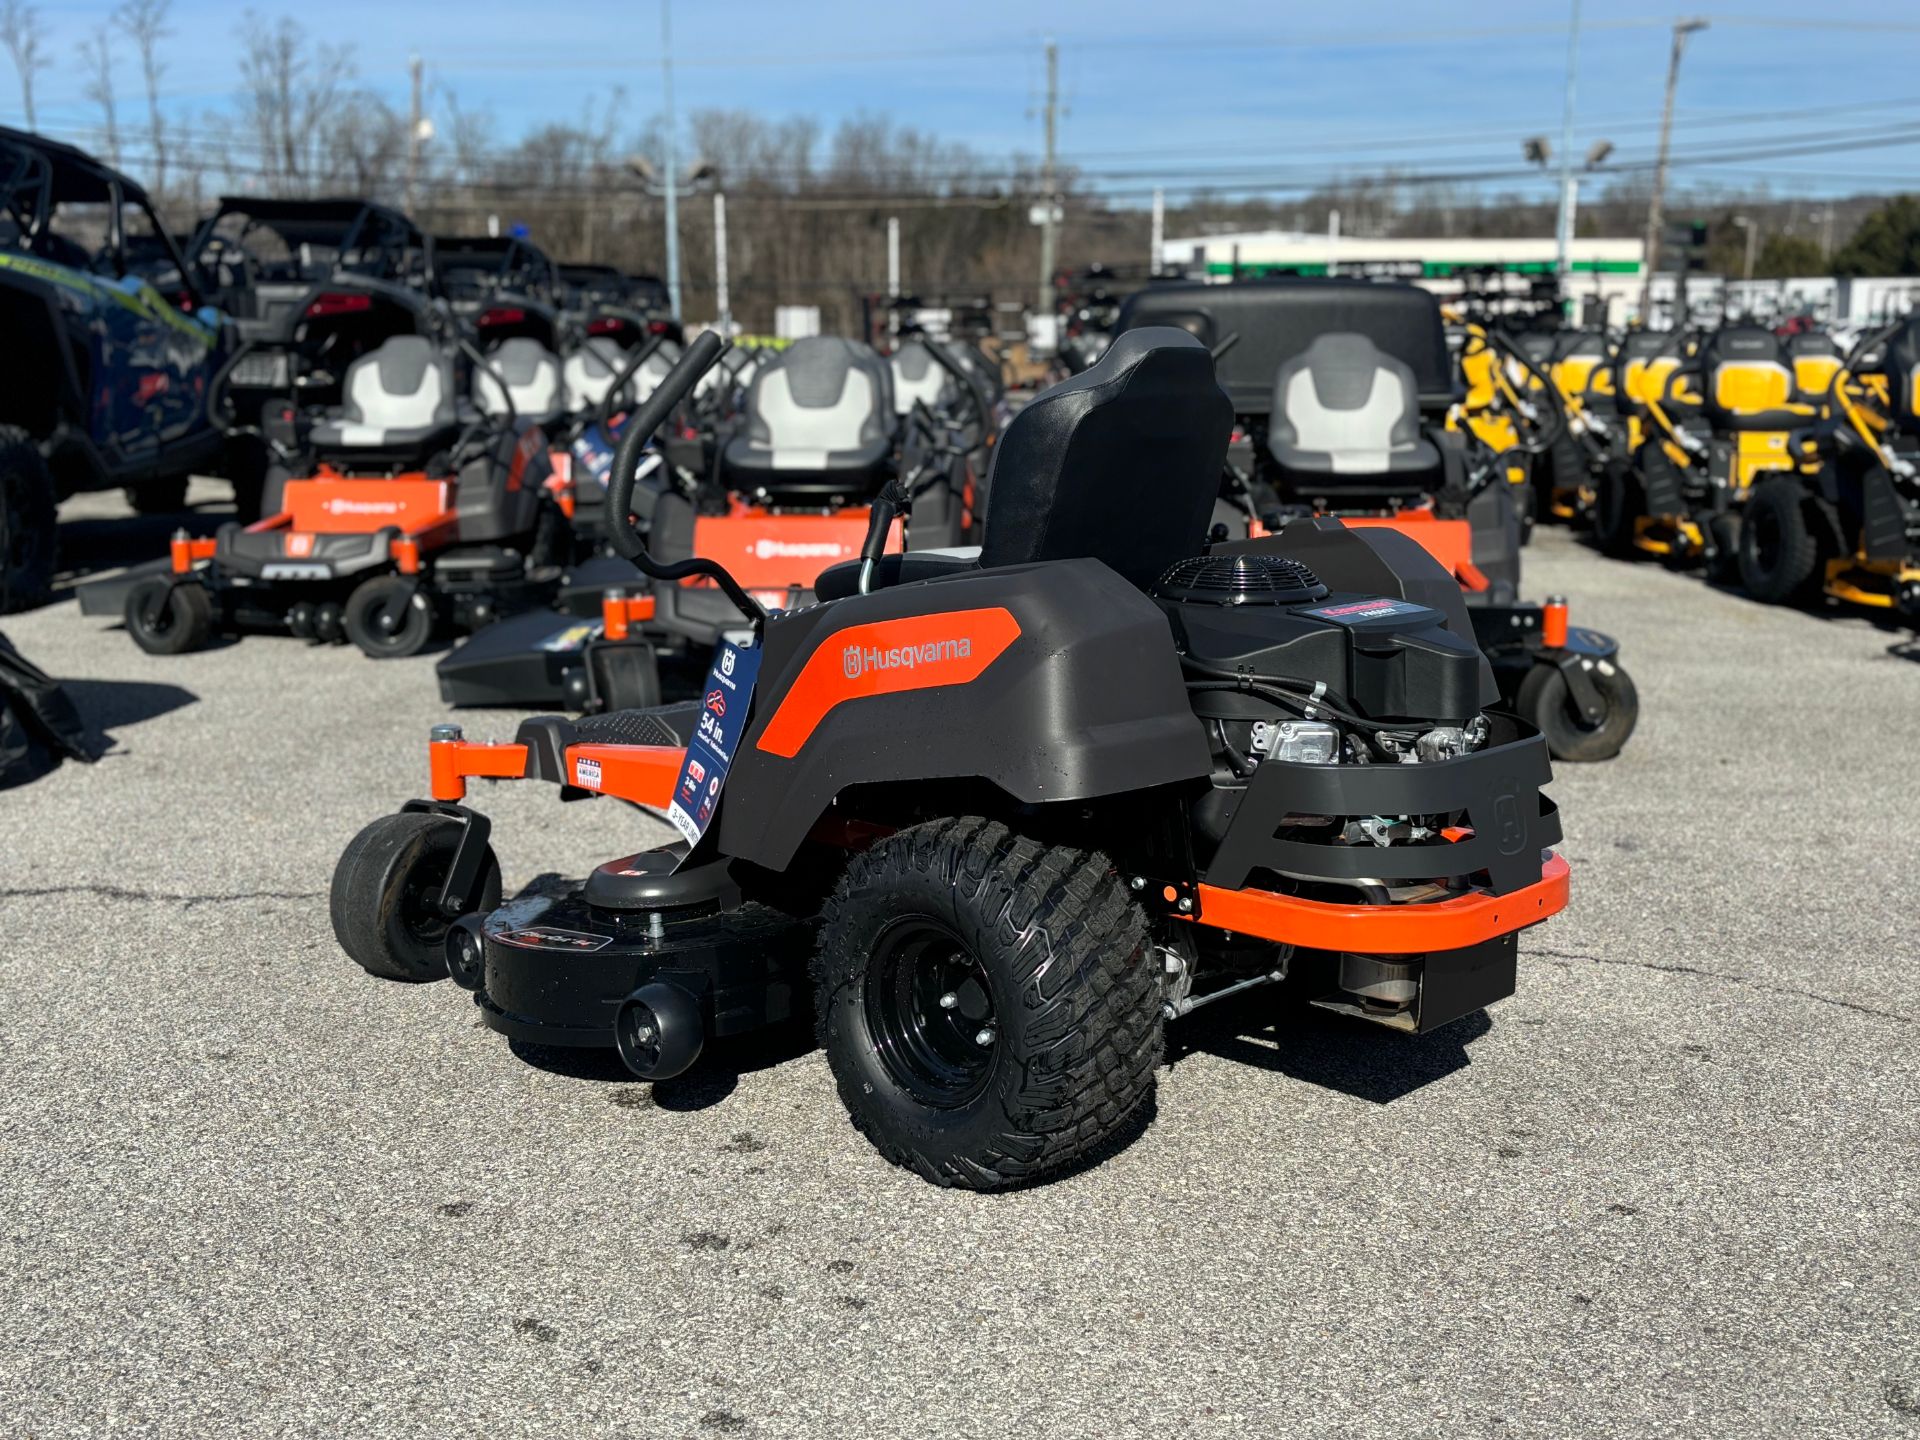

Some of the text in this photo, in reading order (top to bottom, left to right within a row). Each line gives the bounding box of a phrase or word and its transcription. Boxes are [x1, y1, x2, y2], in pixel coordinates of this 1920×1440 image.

[862, 637, 972, 672] Husqvarna
[713, 667, 737, 691] Husqvarna
[701, 711, 715, 734] 54
